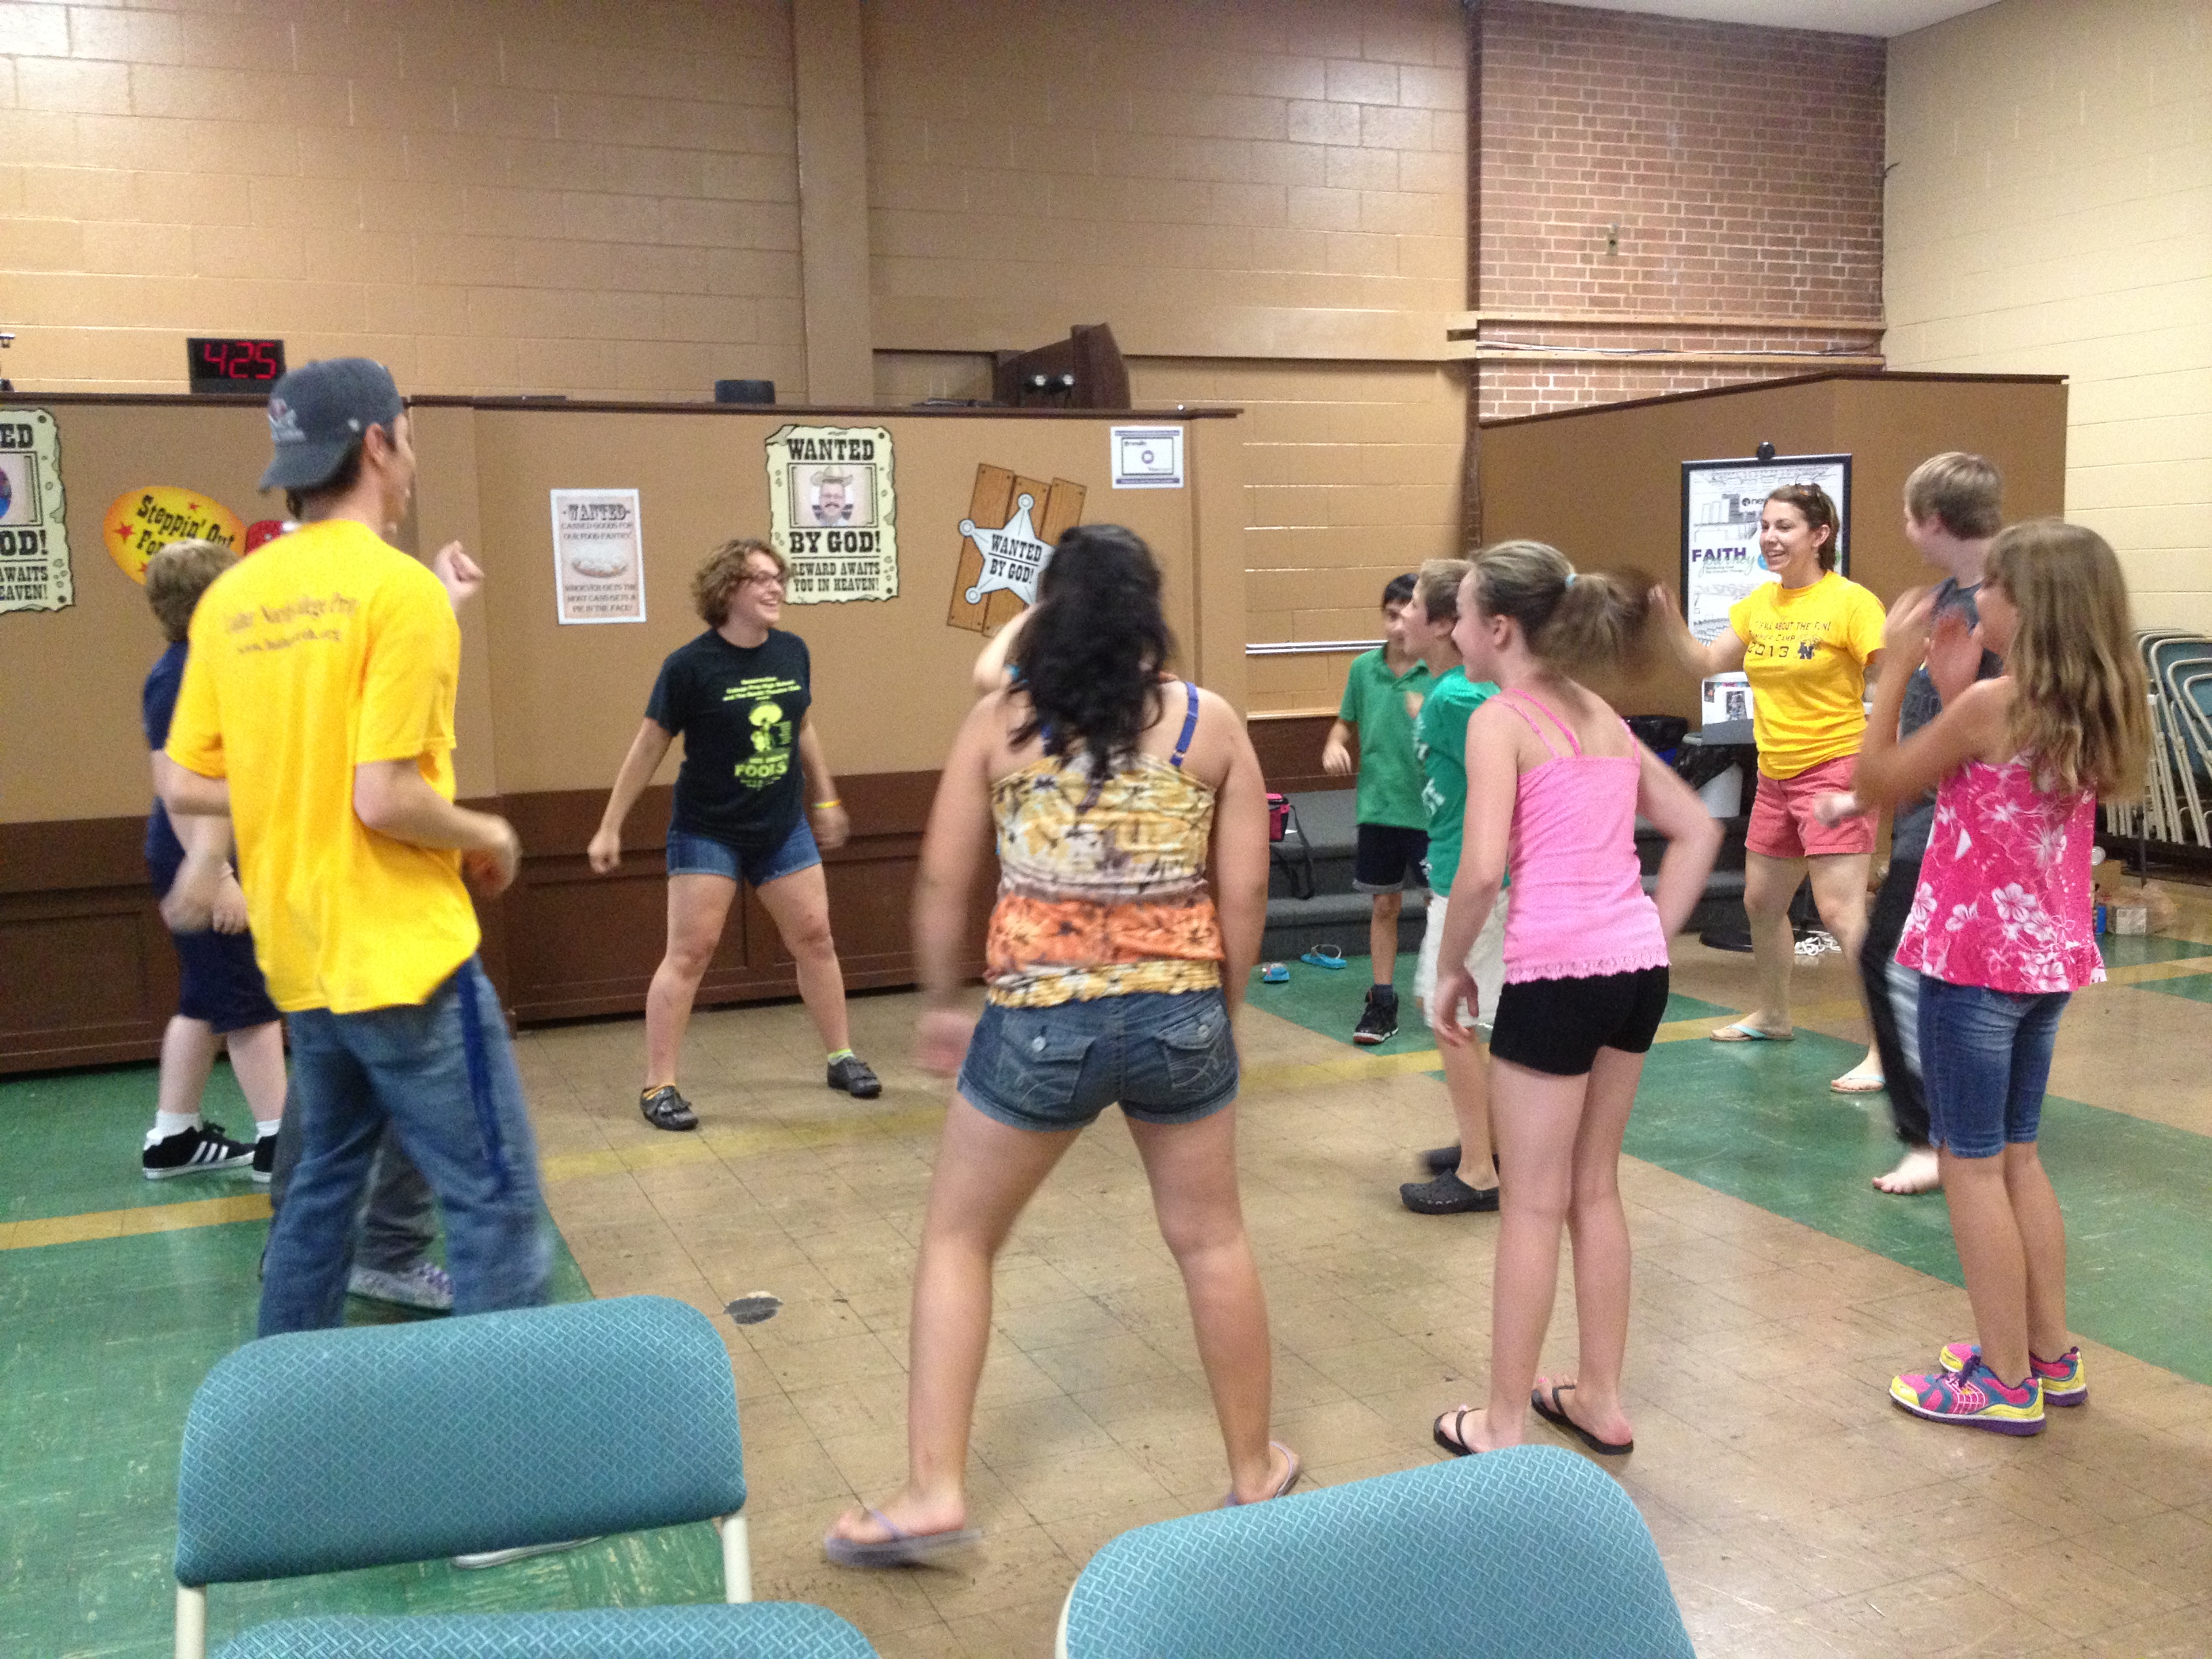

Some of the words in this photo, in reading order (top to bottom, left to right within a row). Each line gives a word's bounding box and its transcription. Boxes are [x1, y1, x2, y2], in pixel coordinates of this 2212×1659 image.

[787, 438, 875, 461] WANTED
[569, 504, 626, 521] WANTED
[790, 531, 821, 553] BY
[827, 531, 881, 553] GOD!
[992, 533, 1042, 562] WANTED
[1692, 547, 1746, 562] FAITH
[792, 562, 836, 576] REWARD
[840, 562, 880, 576] AWAITS
[989, 558, 1006, 577] BY
[1008, 563, 1034, 583] GOD!
[794, 577, 813, 592] YOU
[818, 578, 830, 592] IN
[834, 577, 879, 592] HEAVEN!
[1775, 621, 1795, 630] ABOUT
[1797, 621, 1811, 631] THE
[1747, 642, 1789, 657] 2013
